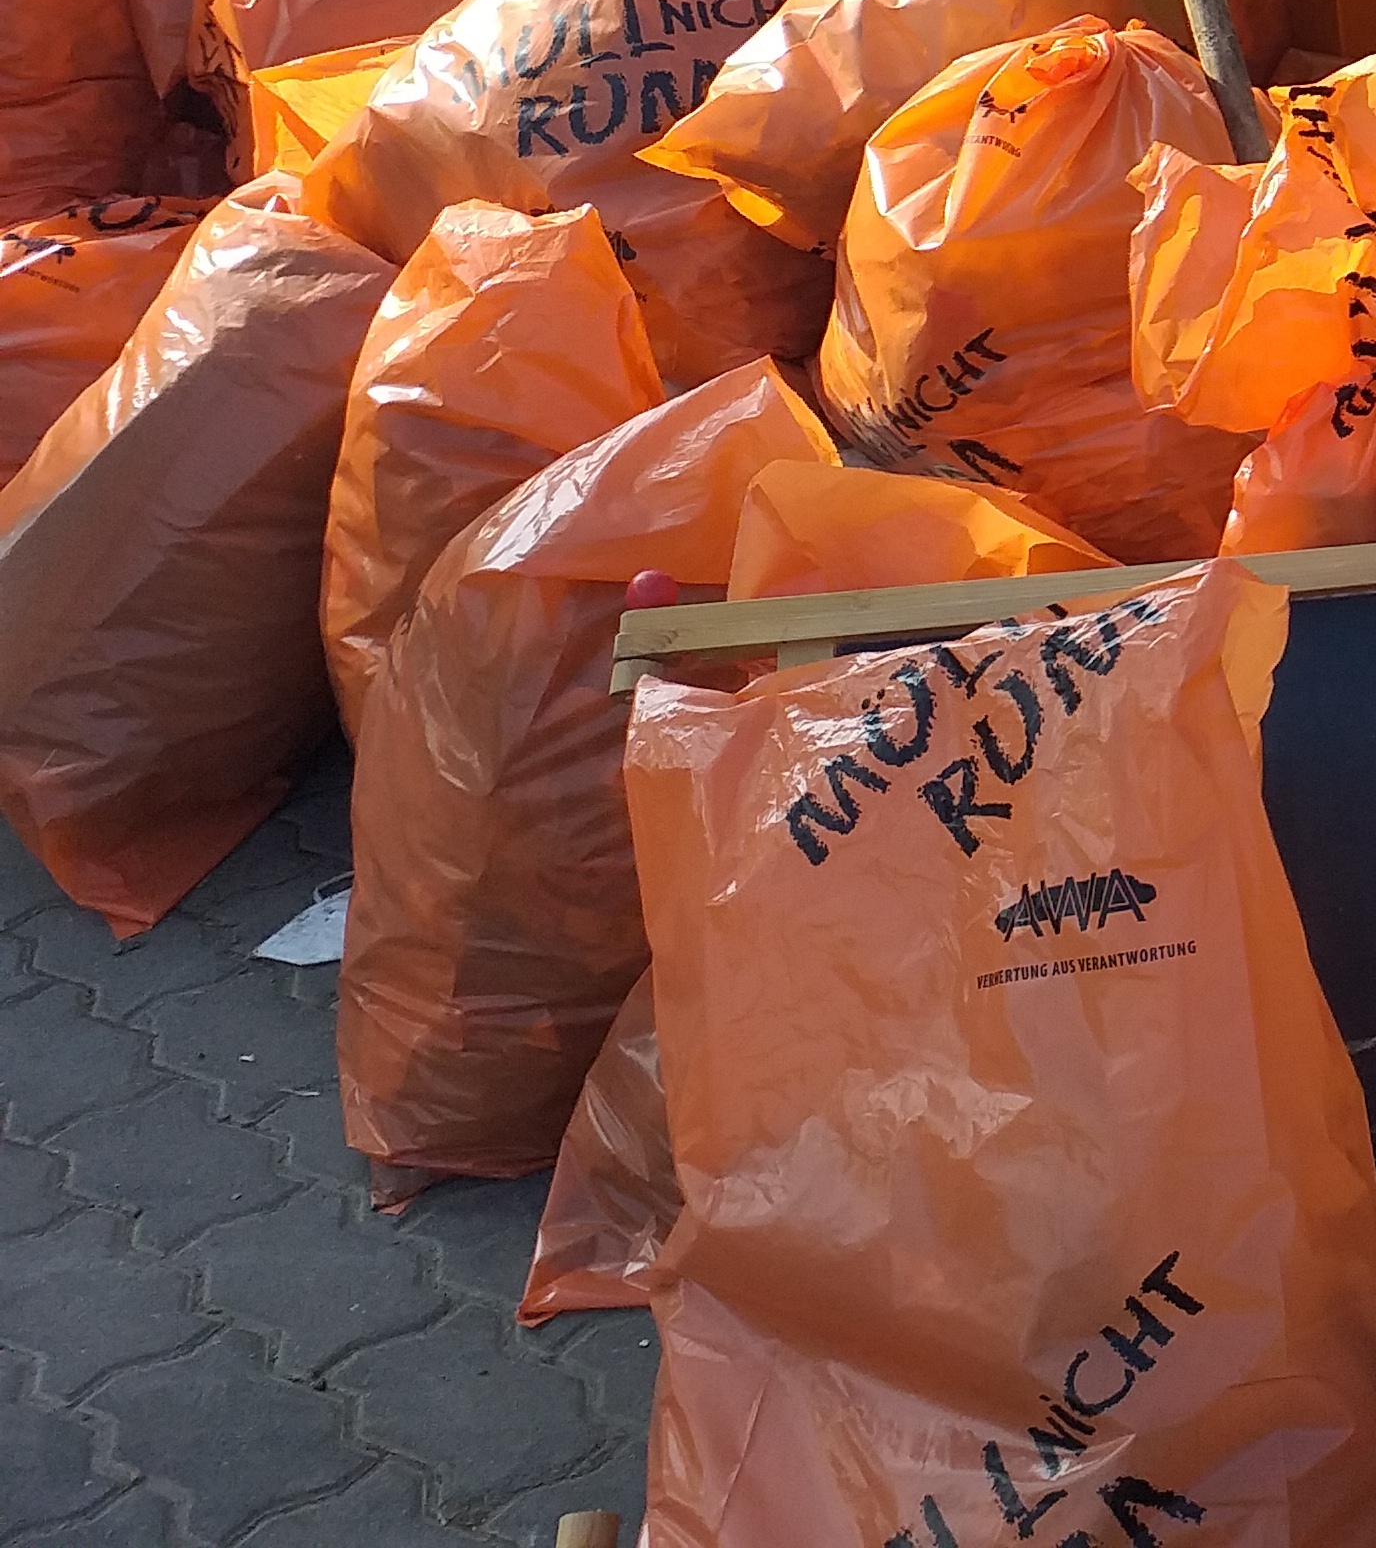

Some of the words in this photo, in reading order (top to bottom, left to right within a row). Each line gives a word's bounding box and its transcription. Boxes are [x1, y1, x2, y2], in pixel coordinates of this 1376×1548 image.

[998, 868, 1153, 942] AWA
[1051, 959, 1077, 977] AUS
[1077, 939, 1198, 973] VERANTWORTUNG
